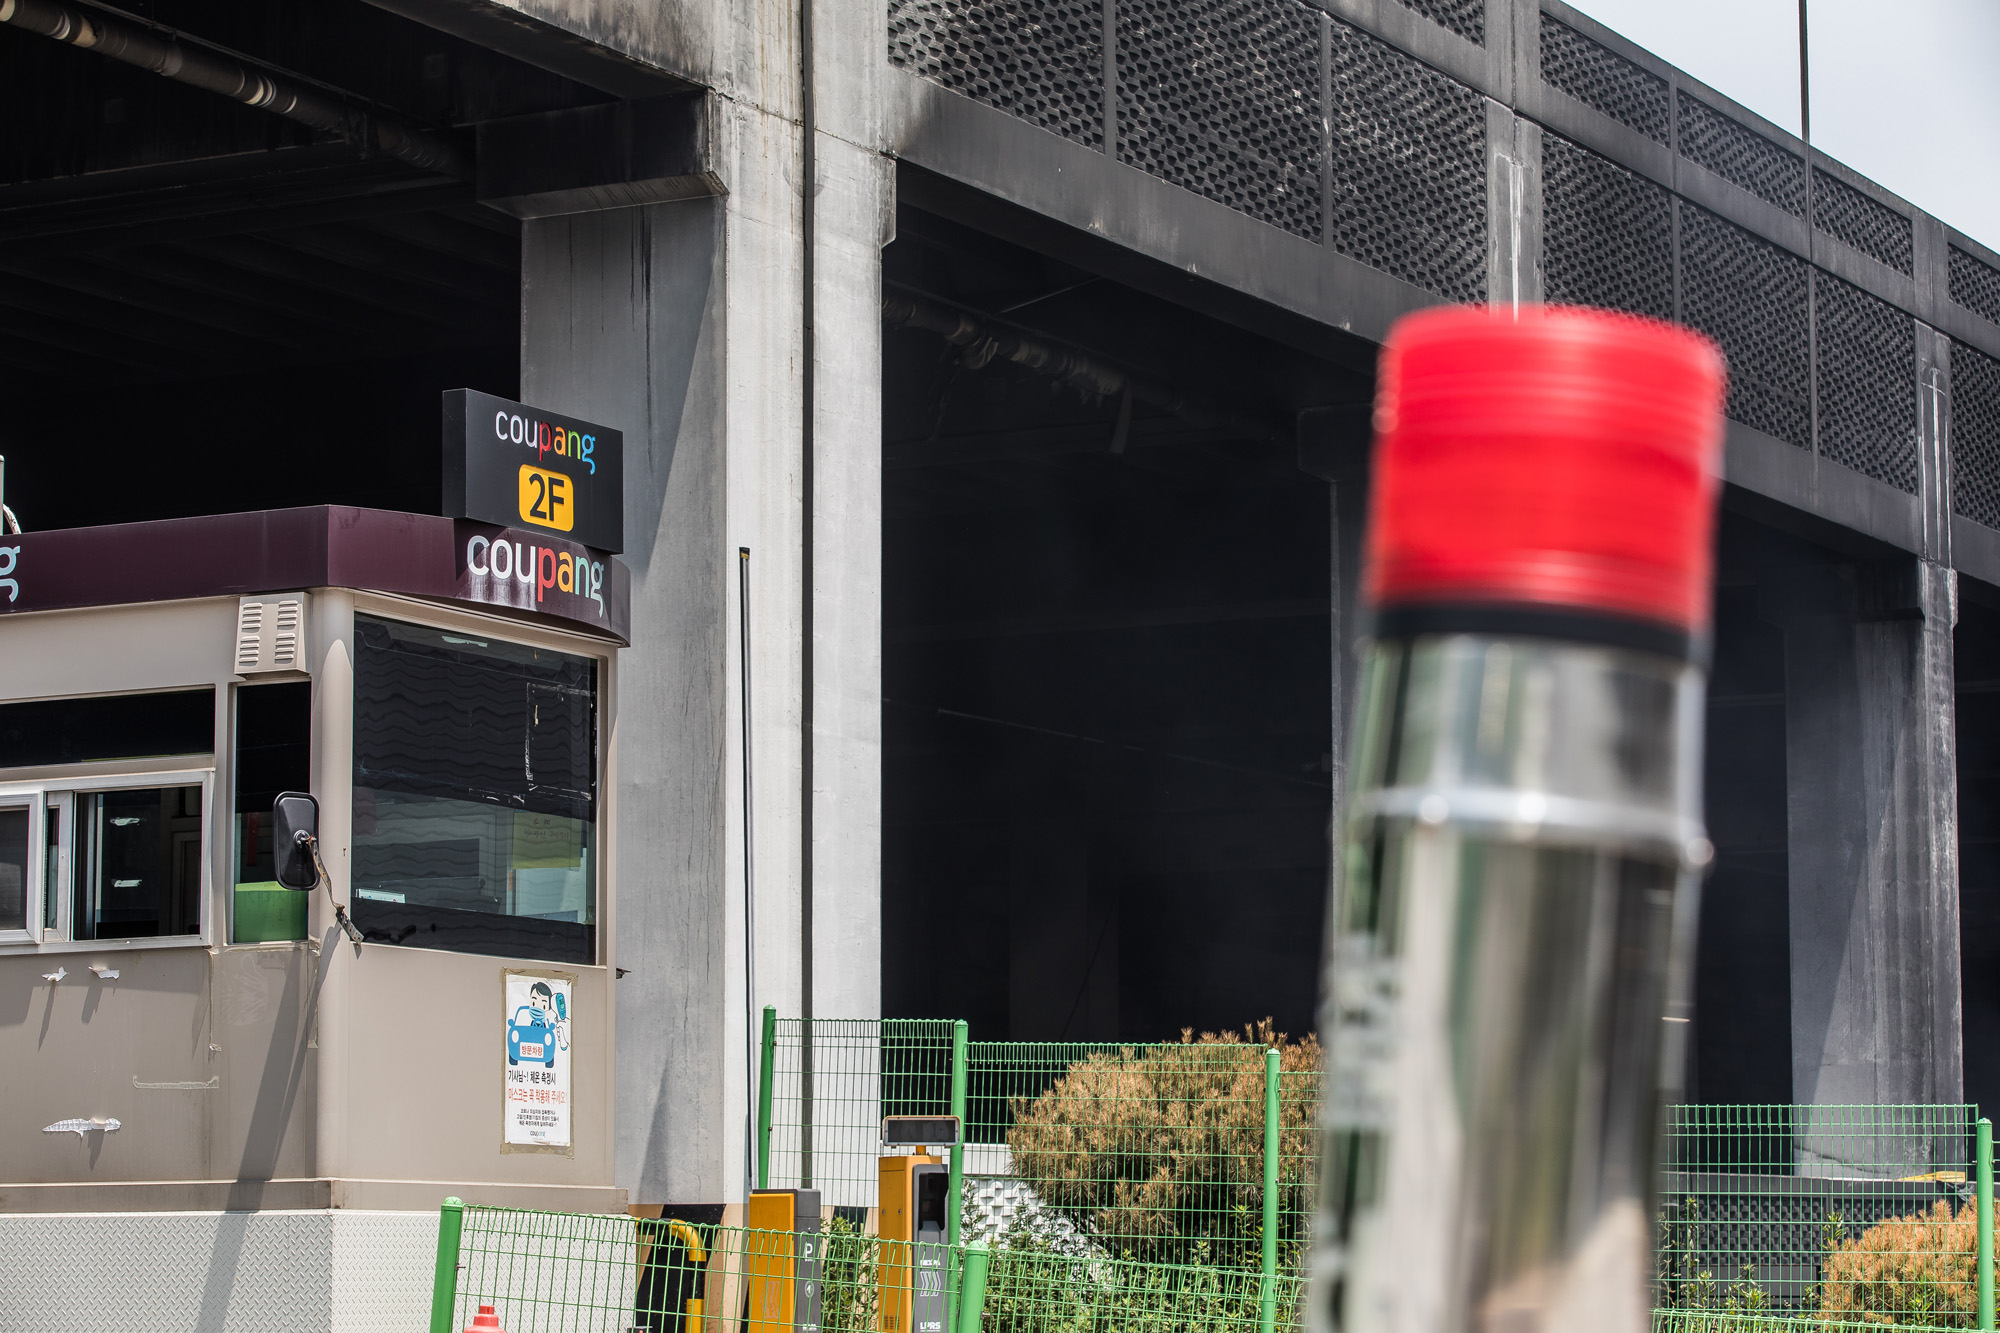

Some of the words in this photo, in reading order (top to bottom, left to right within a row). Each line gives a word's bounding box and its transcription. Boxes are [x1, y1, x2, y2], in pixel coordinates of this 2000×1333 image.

[495, 410, 596, 475] coupang
[528, 473, 565, 522] 2F
[466, 534, 605, 618] coupang
[521, 1045, 543, 1057] 방문차량
[508, 1070, 529, 1083] 기사님~!
[530, 1071, 540, 1084] 체온
[541, 1071, 556, 1085] 측정시
[508, 1087, 528, 1103] 마스크는
[535, 1089, 550, 1105] 착용해
